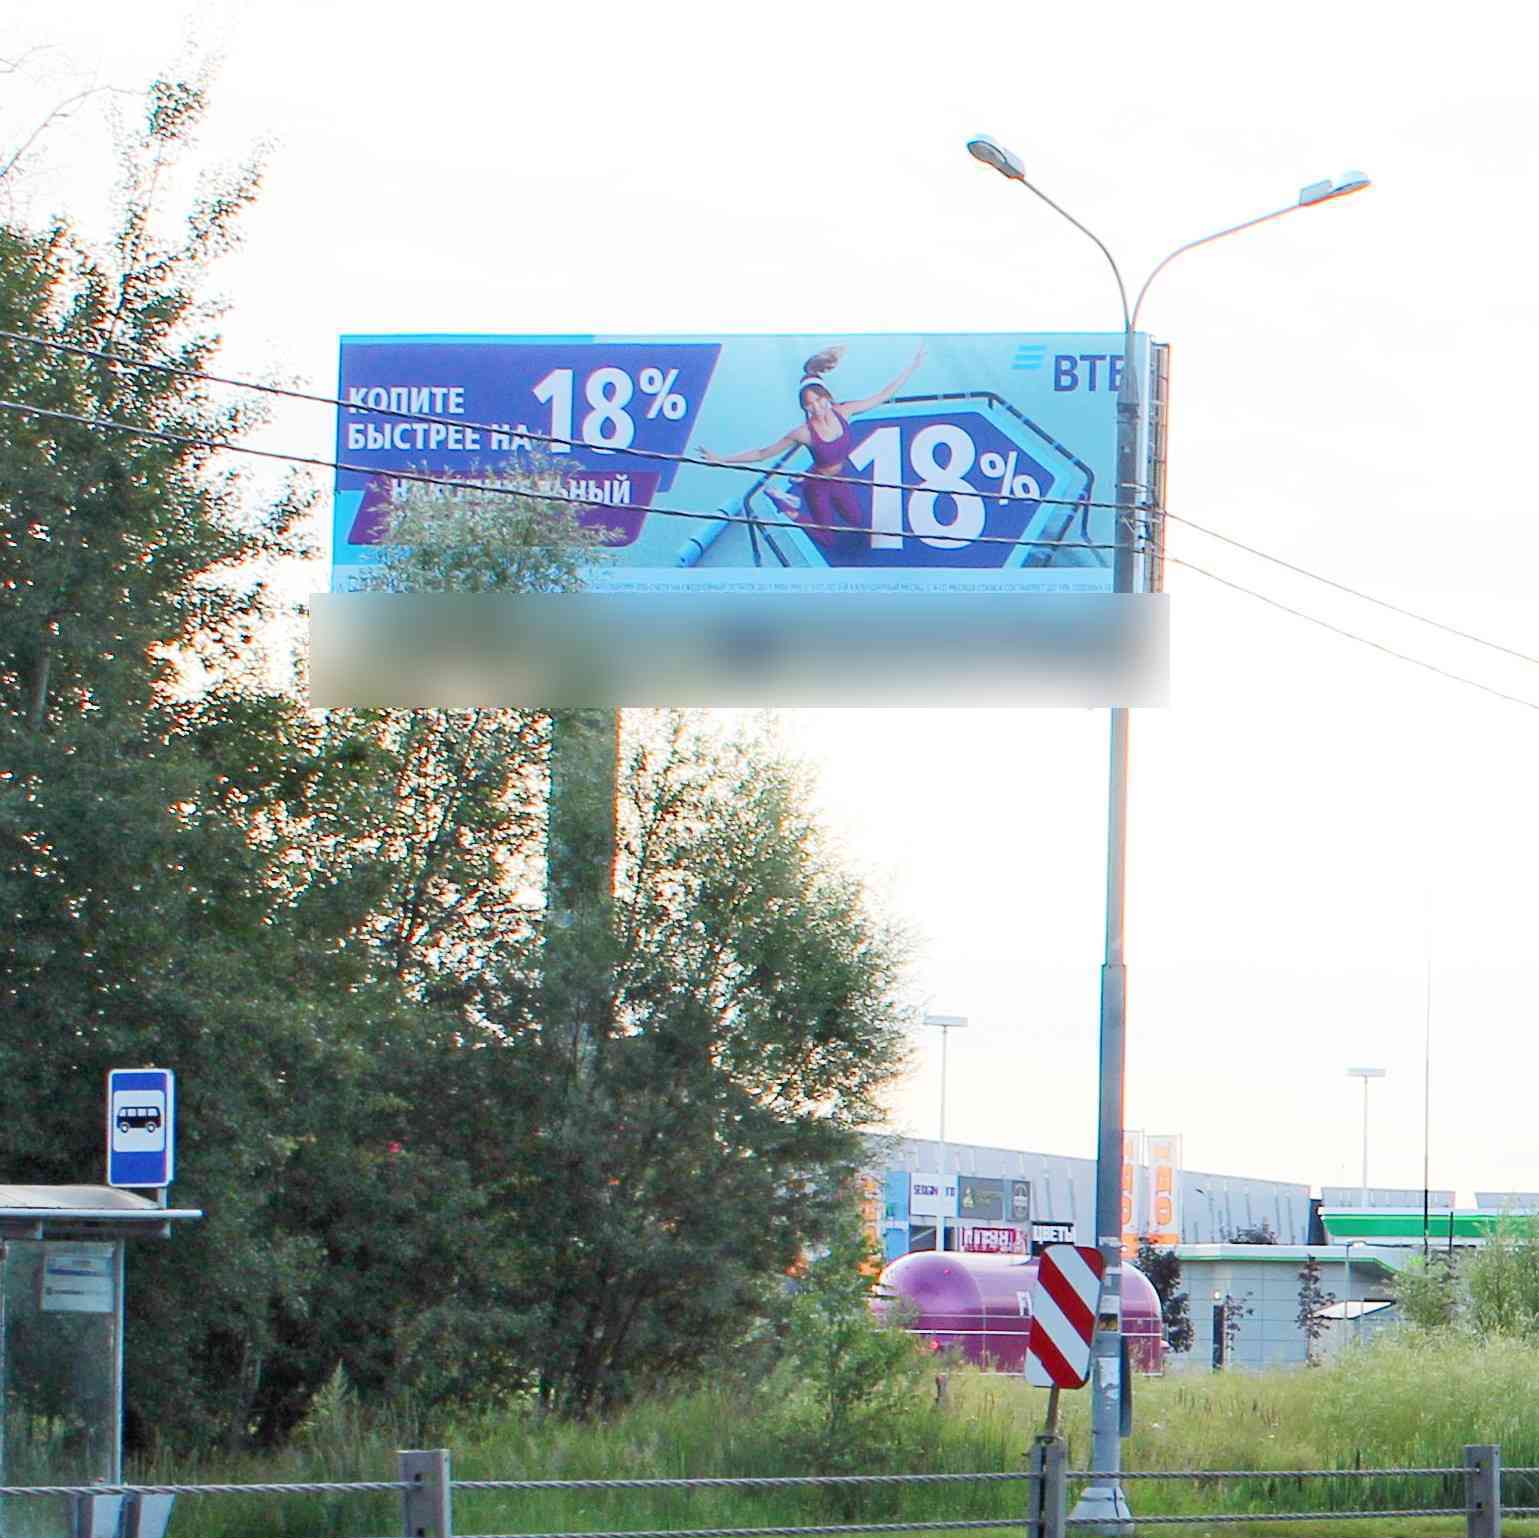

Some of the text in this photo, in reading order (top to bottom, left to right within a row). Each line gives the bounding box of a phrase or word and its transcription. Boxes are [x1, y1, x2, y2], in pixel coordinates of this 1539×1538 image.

[348, 386, 465, 415] КОПИТЕ
[533, 367, 687, 455] 18%
[348, 422, 532, 451] БЫСТРЕЕ НА
[848, 423, 1041, 550] 18%
